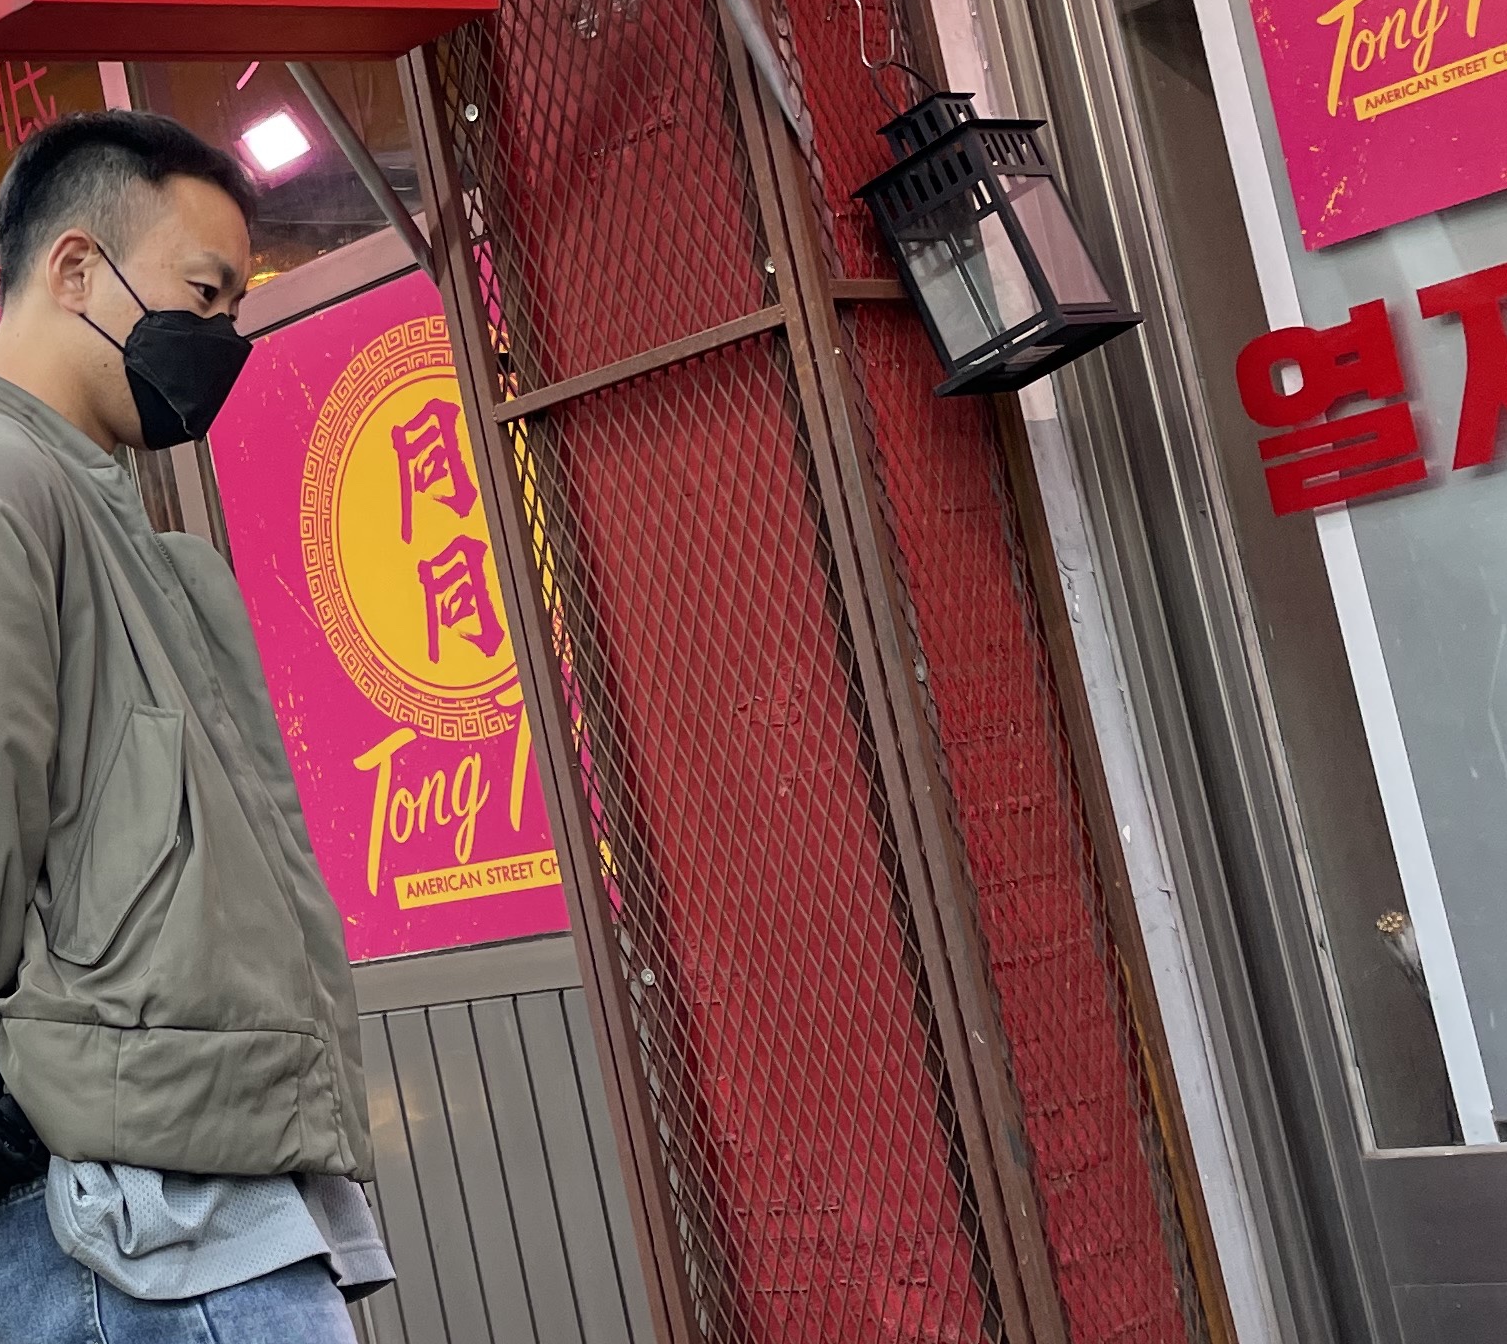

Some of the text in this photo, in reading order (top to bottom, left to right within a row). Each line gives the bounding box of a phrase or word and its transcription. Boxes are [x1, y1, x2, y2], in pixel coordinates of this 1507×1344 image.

[1364, 73, 1440, 113] AMERICAN
[1442, 56, 1488, 84] STREET
[352, 726, 491, 897] Tong
[405, 869, 482, 900] AMERICAN
[486, 860, 534, 885] STREET
